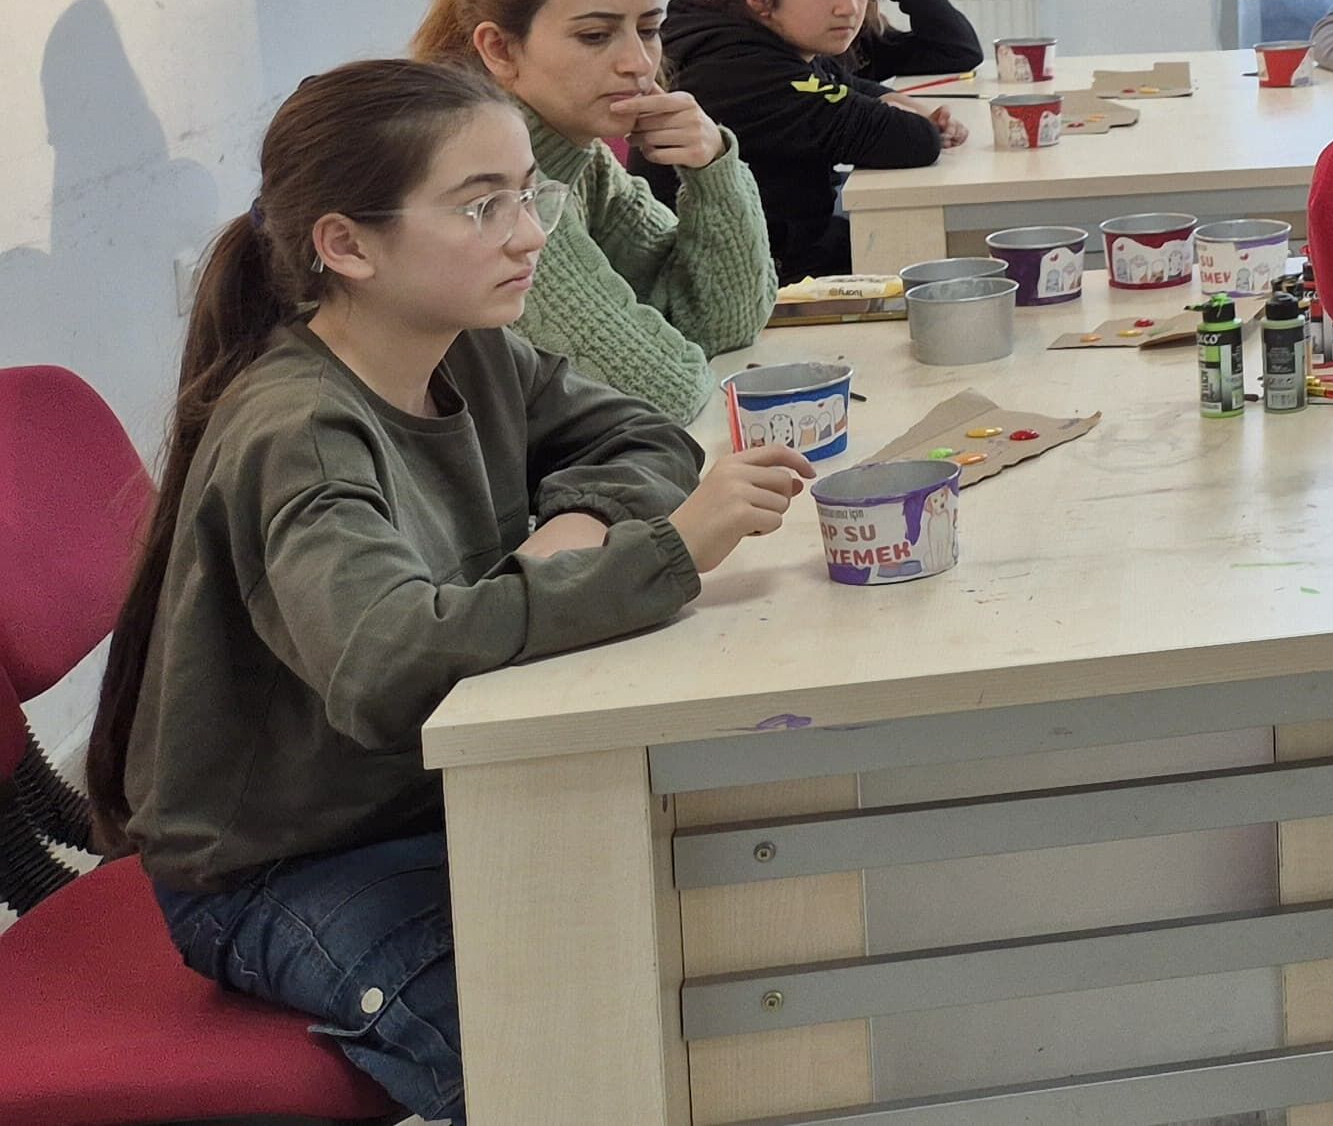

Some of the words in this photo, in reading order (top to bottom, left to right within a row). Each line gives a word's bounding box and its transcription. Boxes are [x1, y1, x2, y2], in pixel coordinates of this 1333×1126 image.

[820, 521, 838, 540] AP
[844, 524, 876, 542] SU
[829, 541, 911, 566] YEMEK
